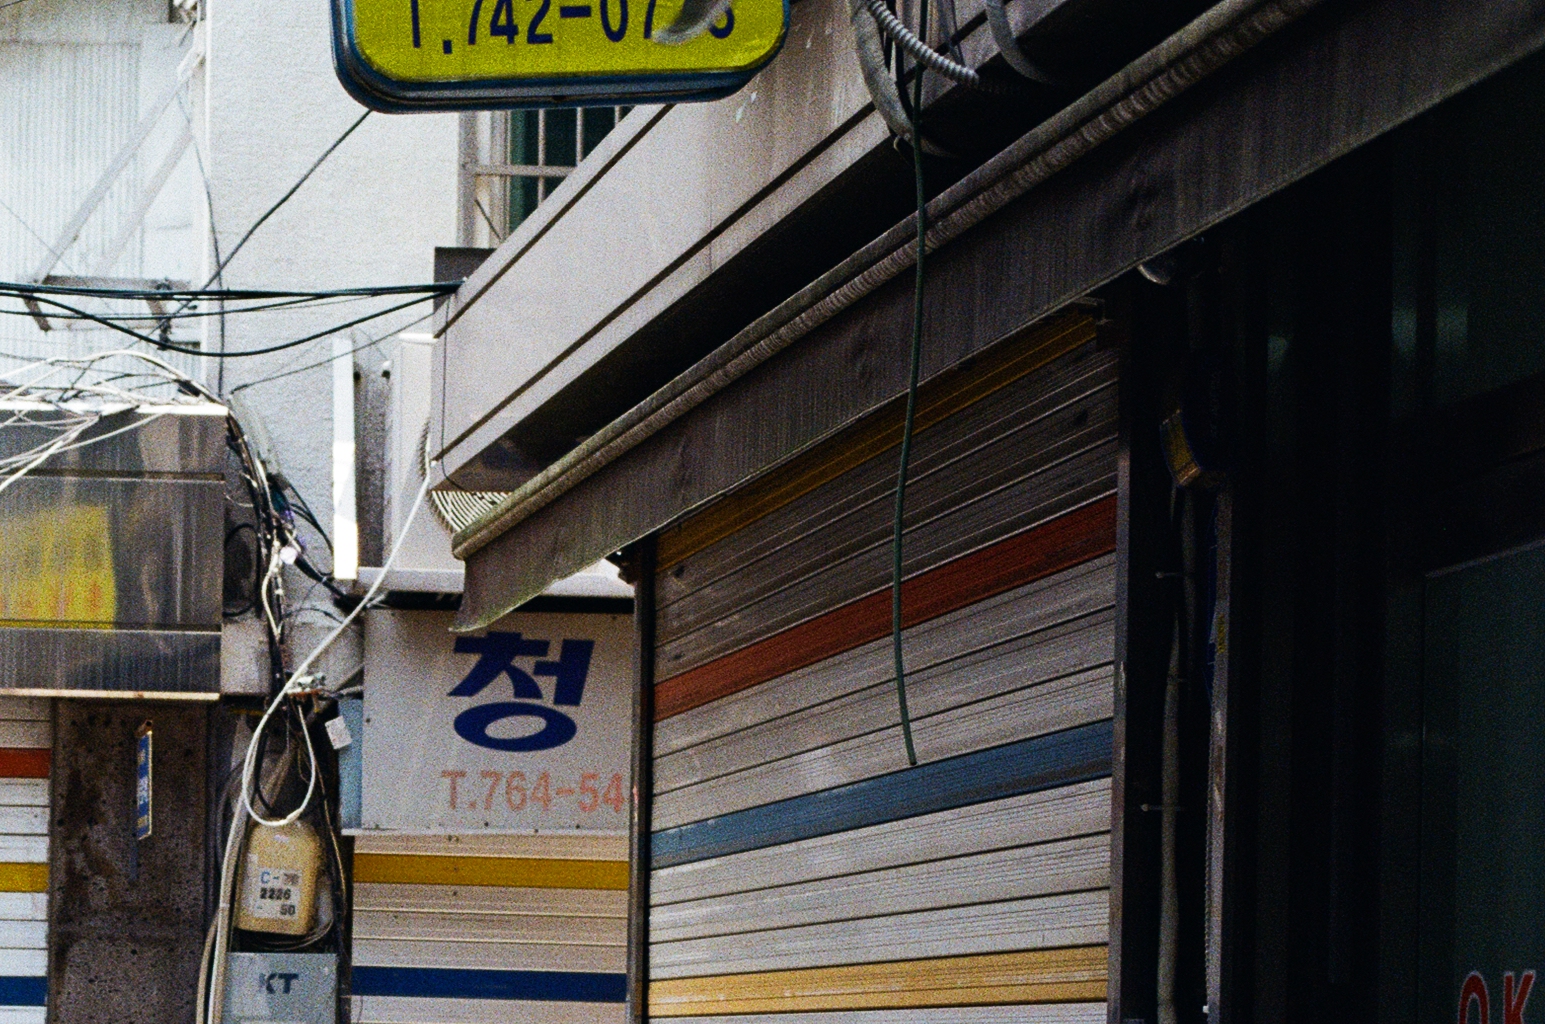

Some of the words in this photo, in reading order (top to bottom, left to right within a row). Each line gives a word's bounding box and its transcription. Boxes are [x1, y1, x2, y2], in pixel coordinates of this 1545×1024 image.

[447, 631, 595, 752] 청
[441, 769, 625, 814] T.764-54
[259, 973, 299, 994] KT
